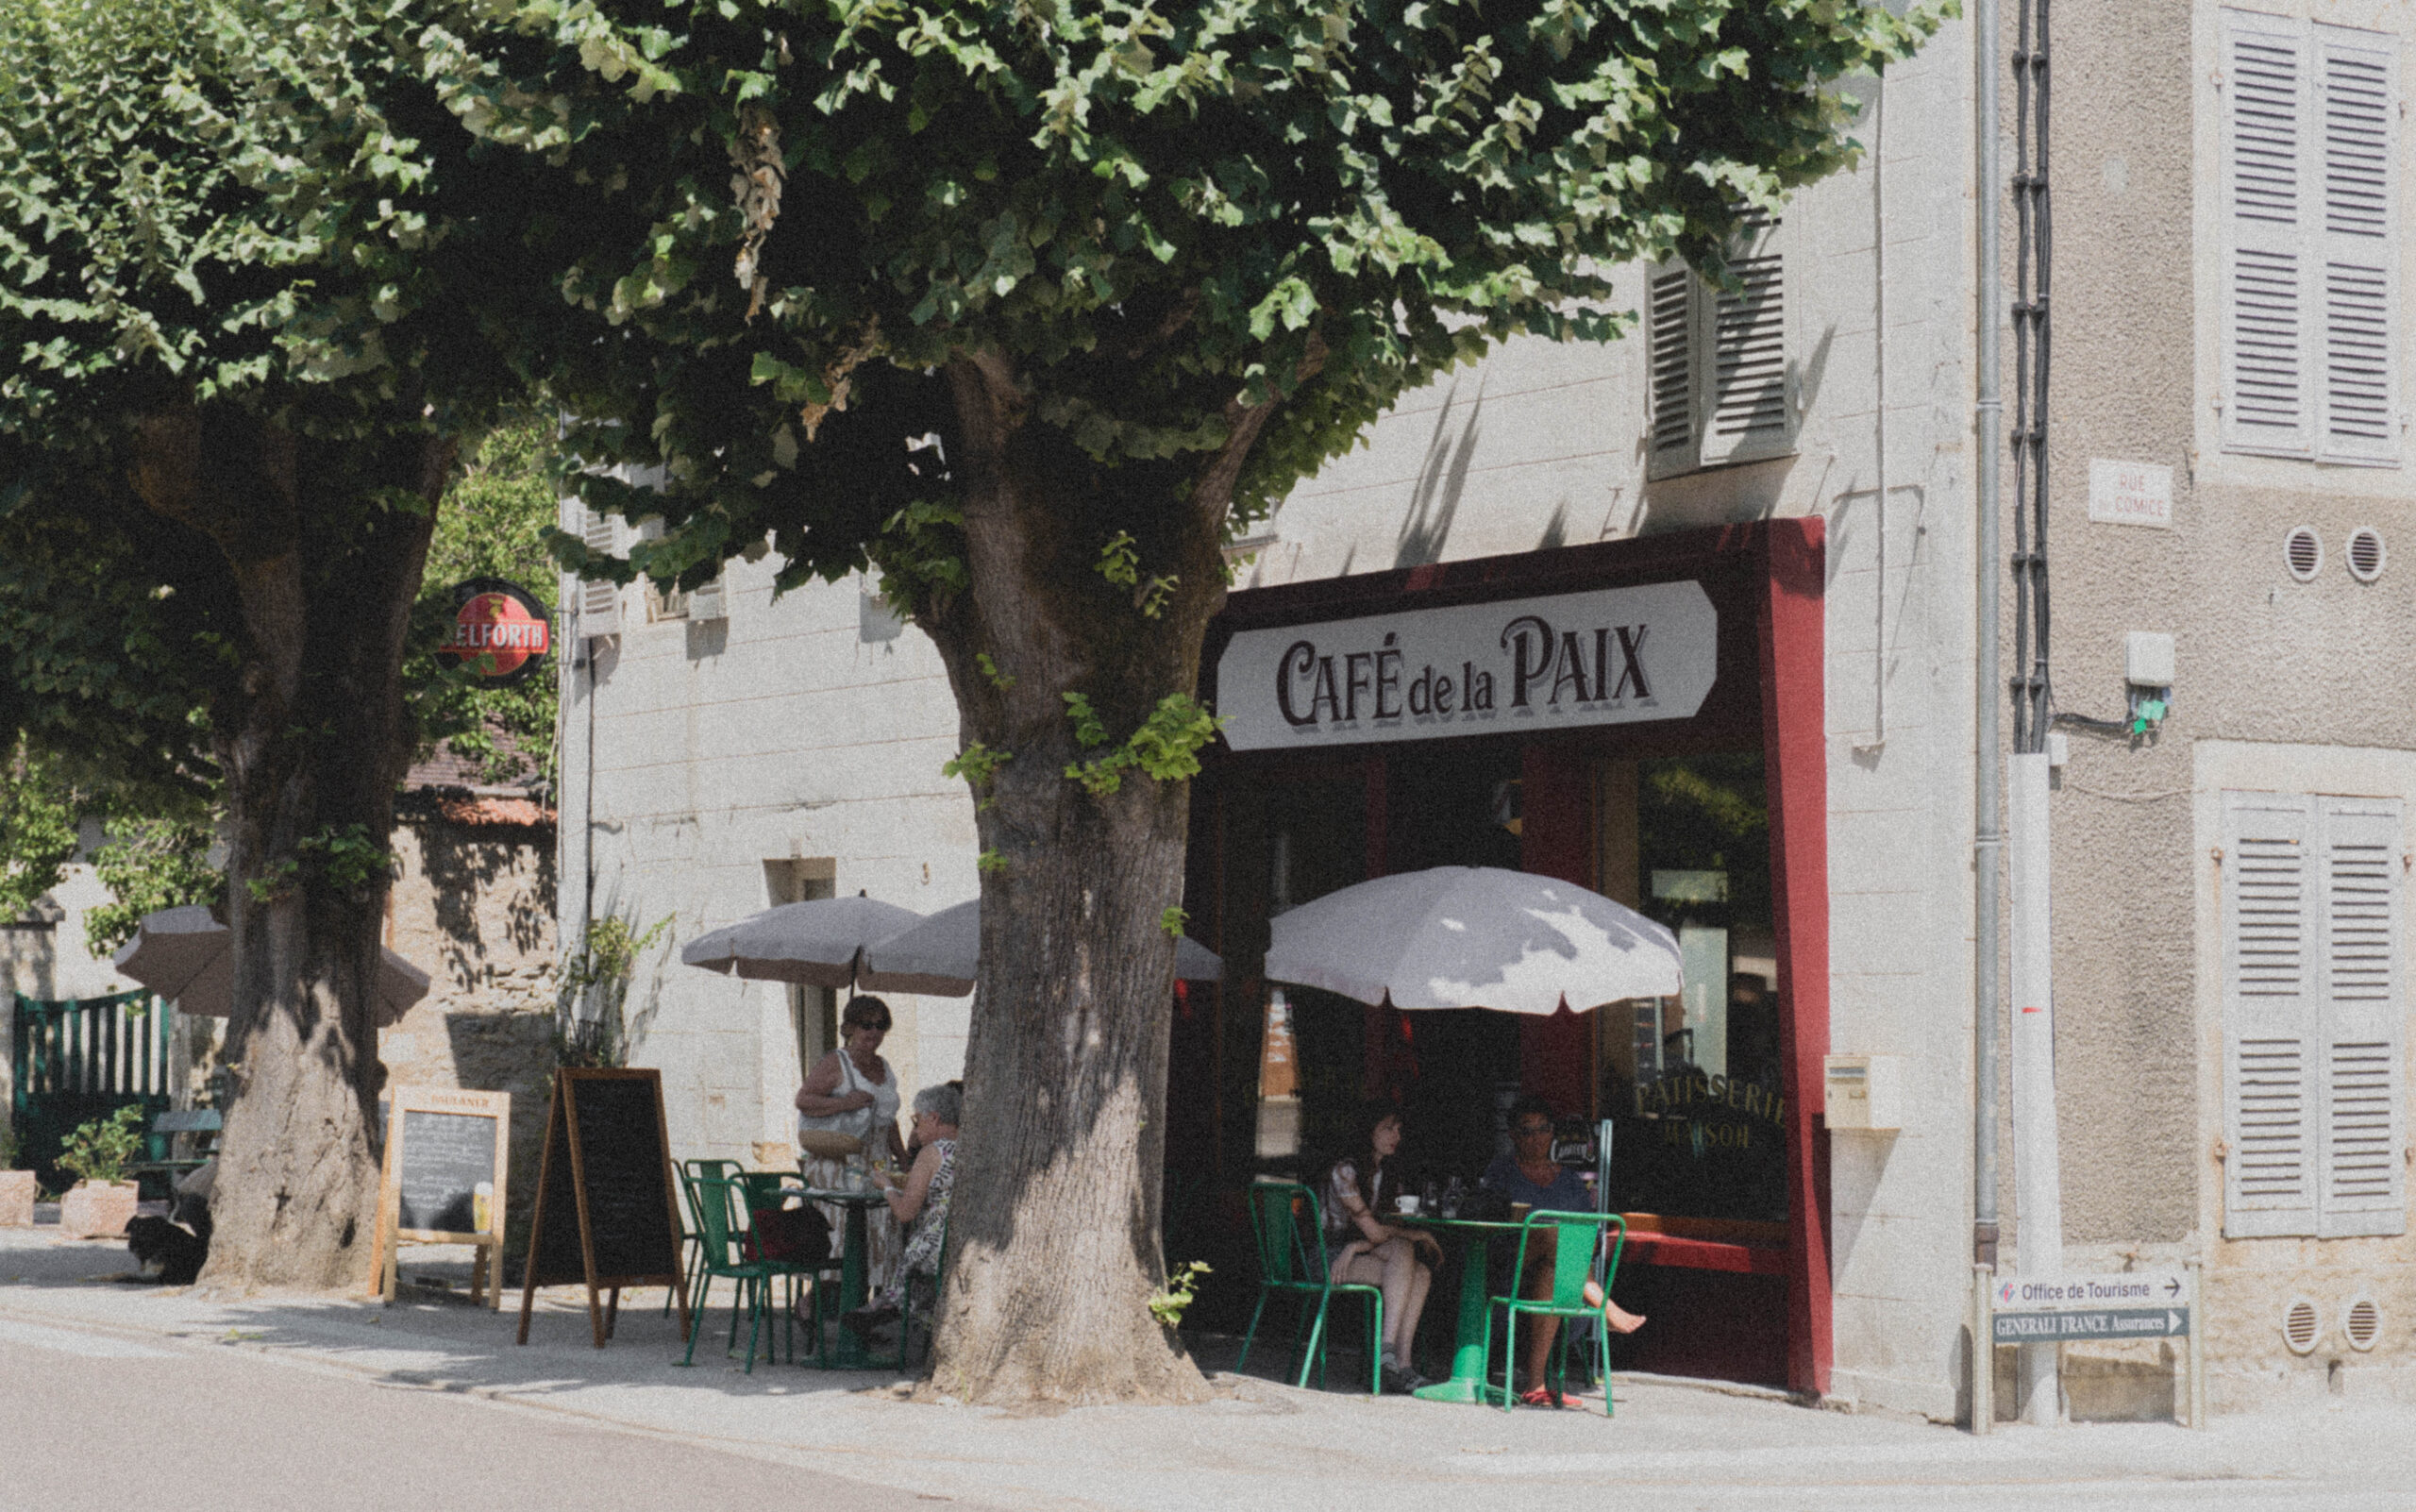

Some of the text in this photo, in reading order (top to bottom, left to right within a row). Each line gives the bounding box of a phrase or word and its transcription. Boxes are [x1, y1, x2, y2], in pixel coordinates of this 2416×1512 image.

[2119, 473, 2145, 493] RUE
[454, 623, 544, 647] ELFORTH
[1276, 615, 1651, 729] CAFÉ de la PAIX
[2022, 1282, 2151, 1301] Office de Tourisme
[1996, 1315, 2166, 1336] GENERALI FRANCE Assurances
